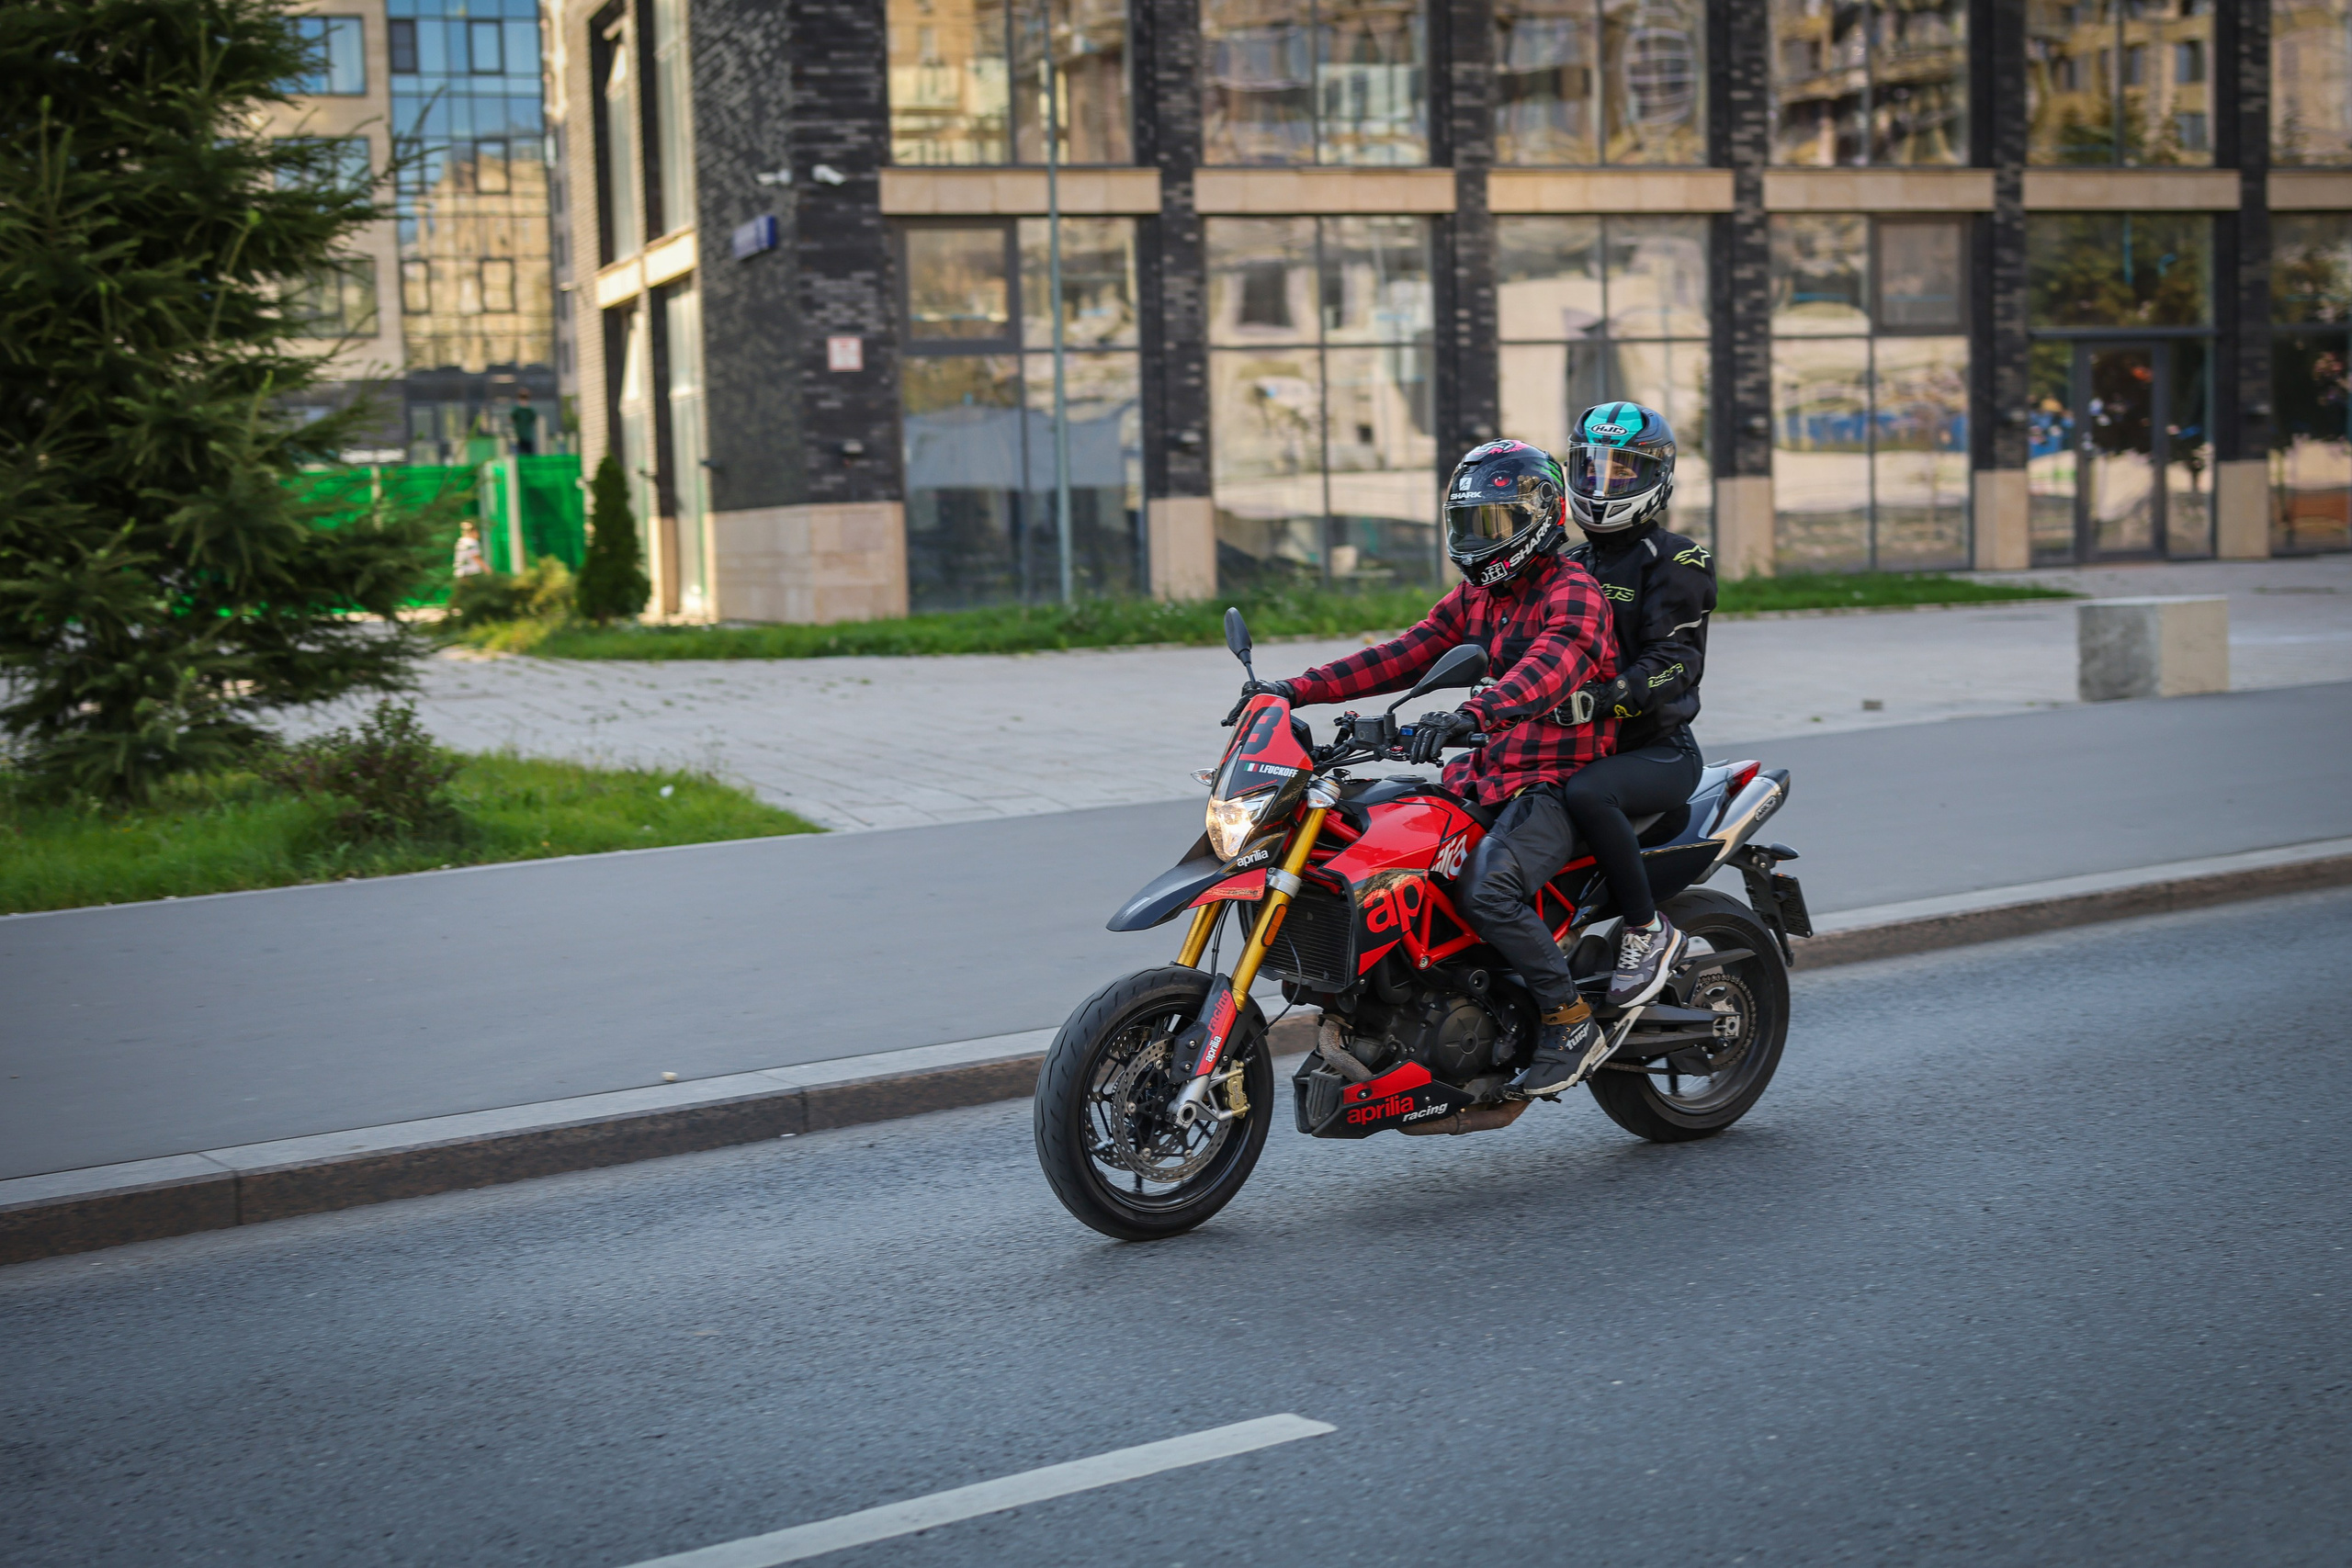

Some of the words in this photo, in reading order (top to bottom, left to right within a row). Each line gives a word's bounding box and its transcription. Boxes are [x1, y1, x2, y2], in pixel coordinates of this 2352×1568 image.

[1595, 425, 1623, 434] HJC
[1450, 491, 1483, 501] SHARK
[1510, 516, 1553, 568] SHARK
[1237, 849, 1269, 867] aprilia
[1363, 874, 1426, 933] ap
[1207, 988, 1232, 1033] racing
[1205, 1035, 1223, 1063] aprilia
[1346, 1094, 1415, 1125] aprilia
[1402, 1102, 1449, 1122] racing
